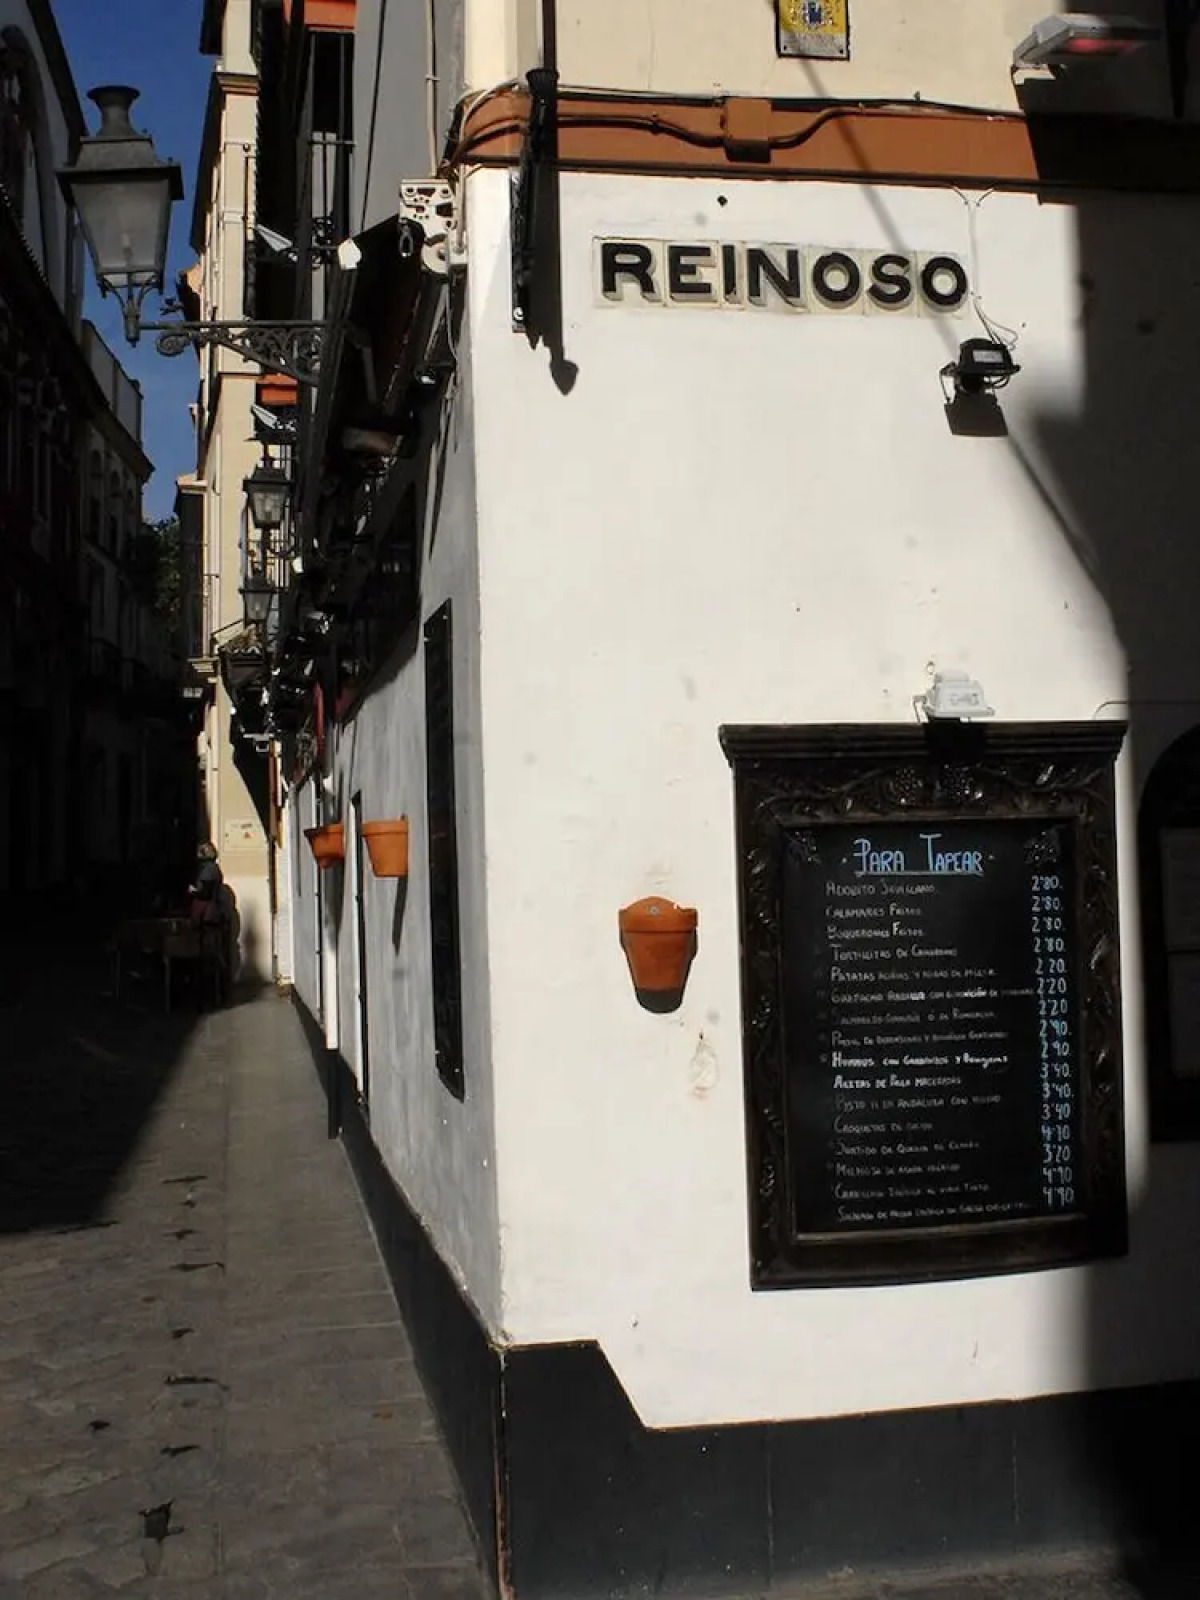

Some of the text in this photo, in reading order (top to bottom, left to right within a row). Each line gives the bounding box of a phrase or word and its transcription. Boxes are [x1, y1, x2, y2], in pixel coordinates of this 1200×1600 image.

[601, 241, 968, 308] REINOSO
[853, 833, 983, 872] PARA TAPEAR
